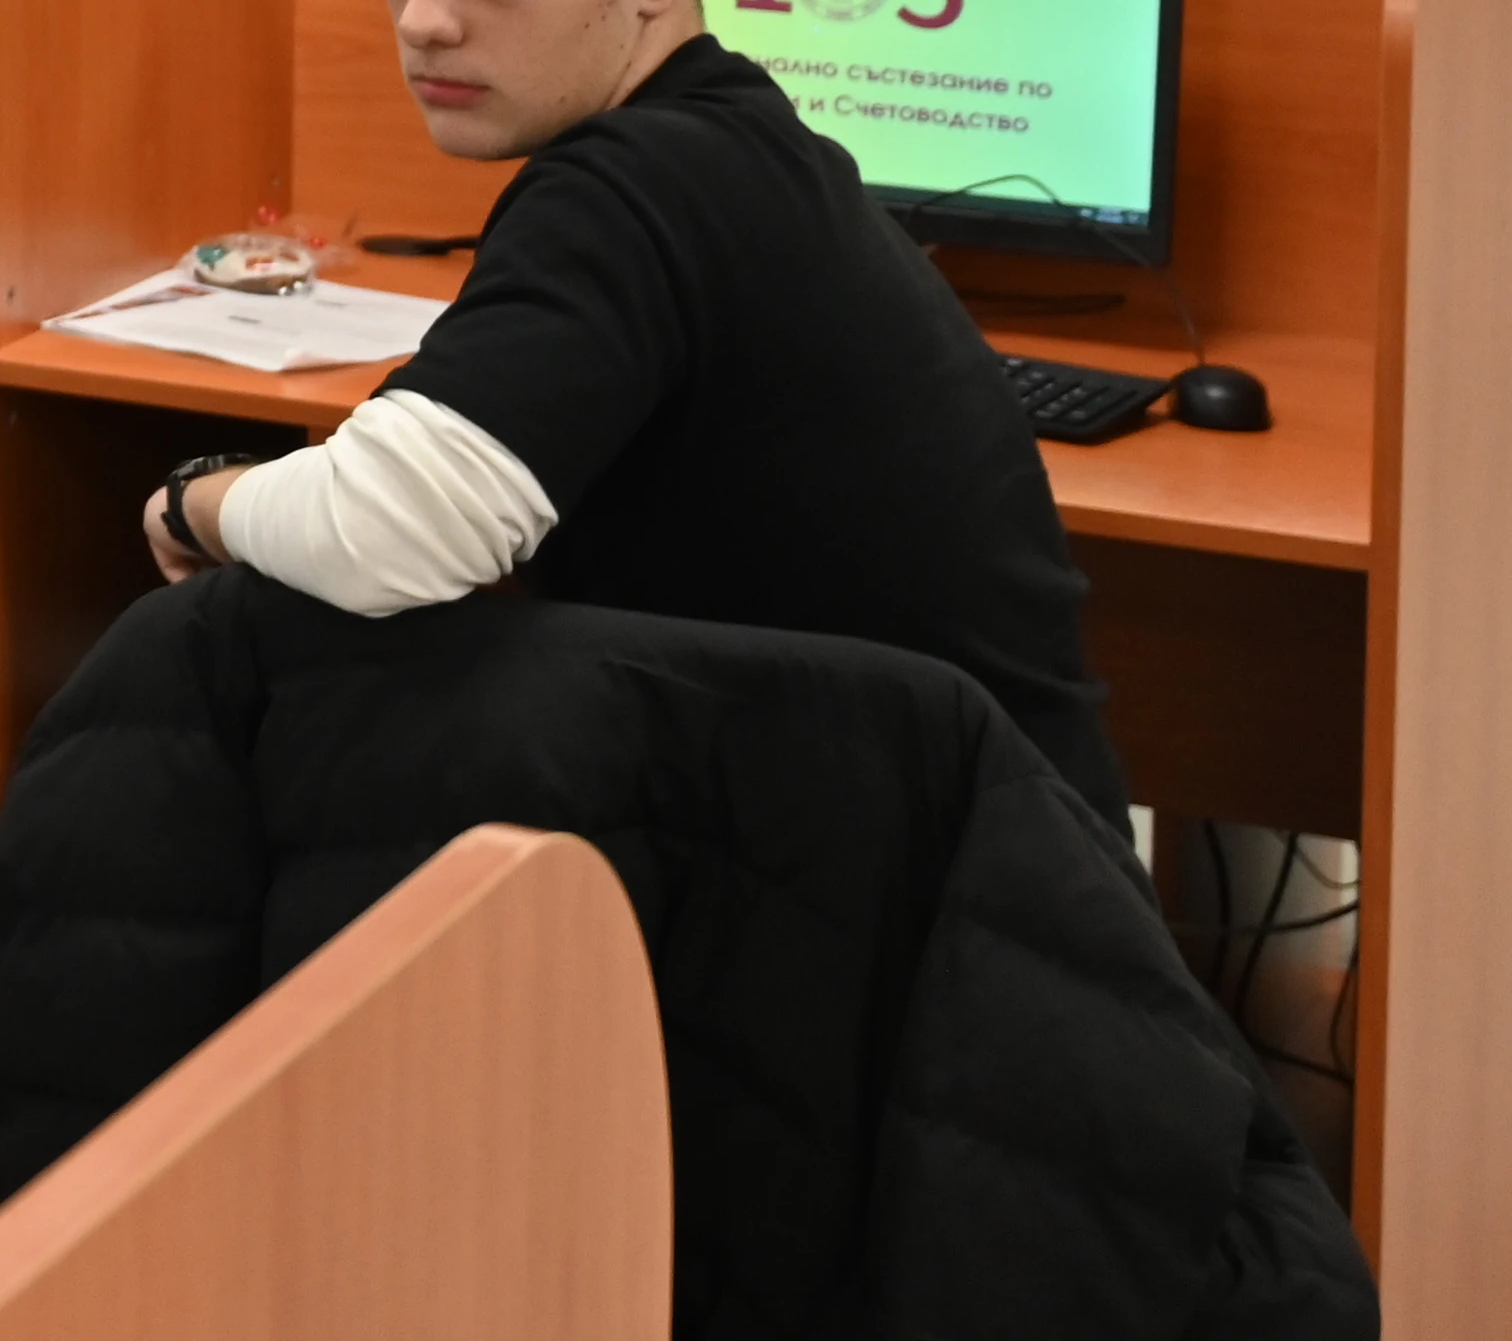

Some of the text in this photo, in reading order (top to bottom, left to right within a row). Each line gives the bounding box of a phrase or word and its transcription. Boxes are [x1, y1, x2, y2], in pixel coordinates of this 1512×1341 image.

[846, 63, 1009, 95] състезание
[1017, 79, 1054, 100] по
[809, 97, 826, 112] и
[833, 93, 1031, 134] Счетоводство
